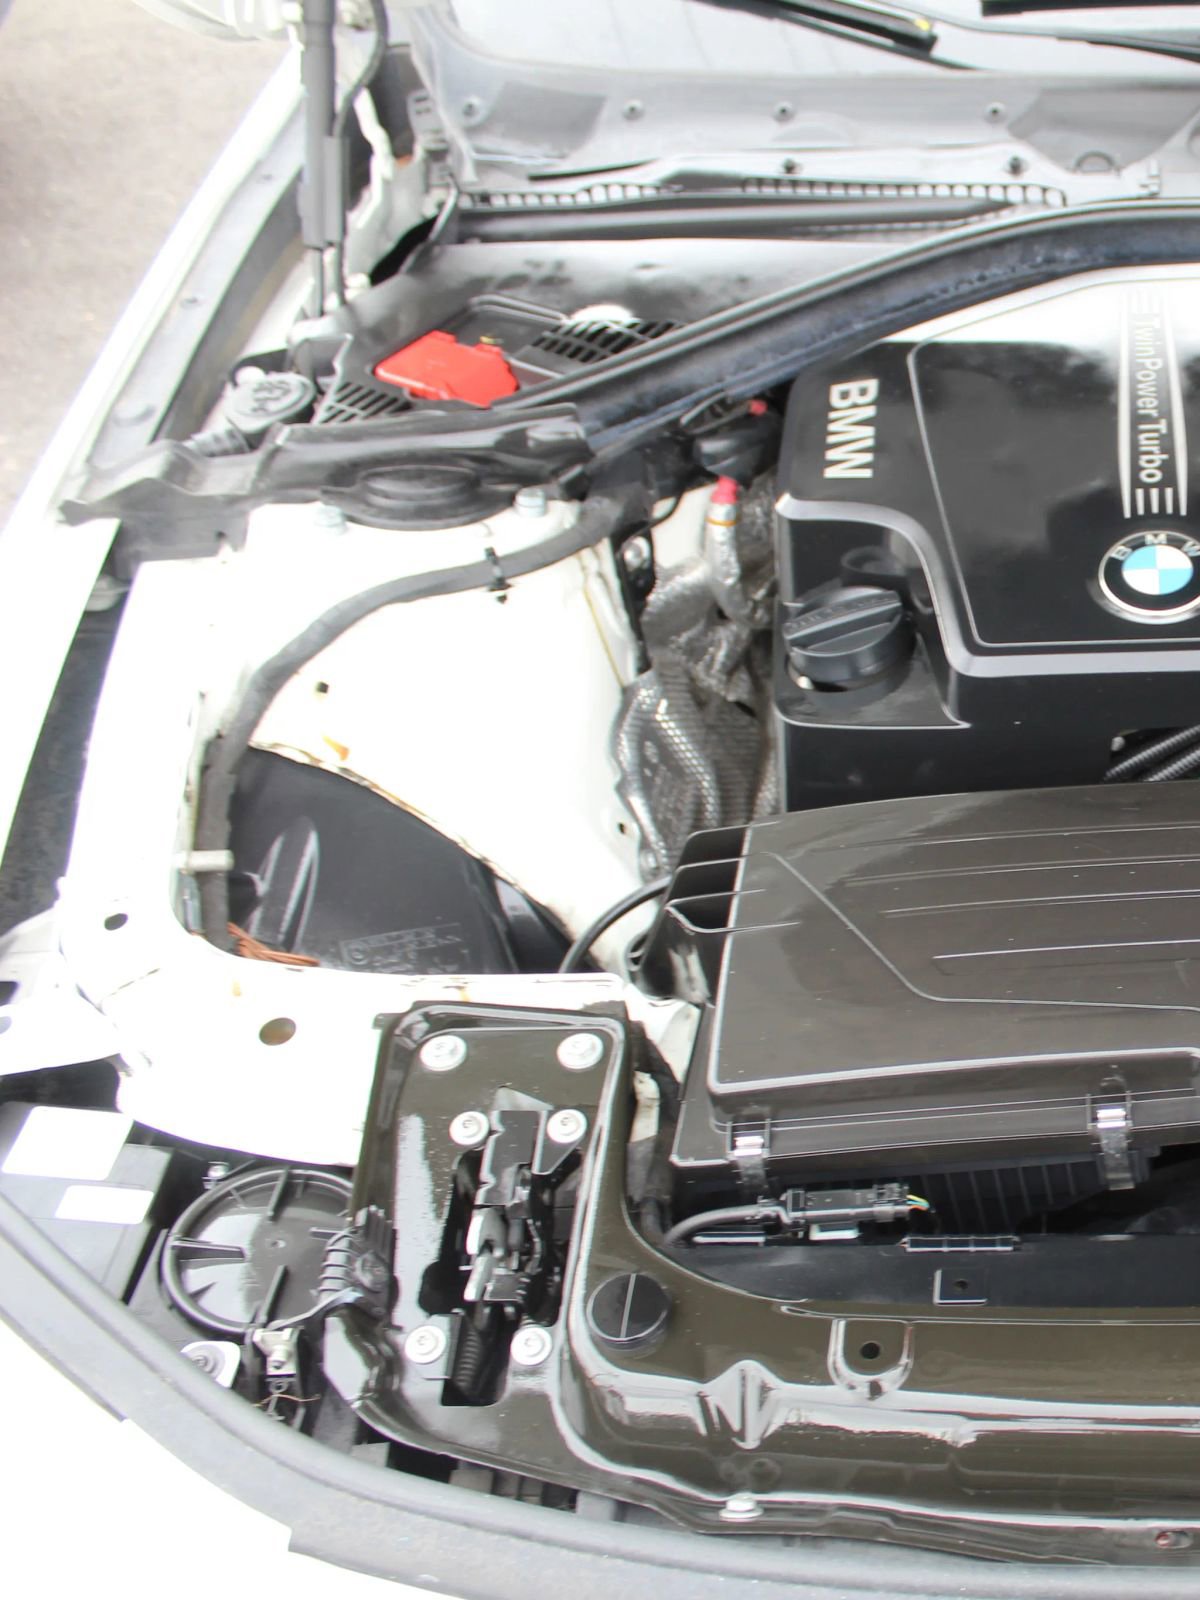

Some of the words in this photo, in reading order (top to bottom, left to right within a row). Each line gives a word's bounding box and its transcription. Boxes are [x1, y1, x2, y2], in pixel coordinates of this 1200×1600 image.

[1135, 317, 1163, 418] TwinPower
[823, 378, 880, 479] BMW
[1138, 418, 1169, 483] Turbo
